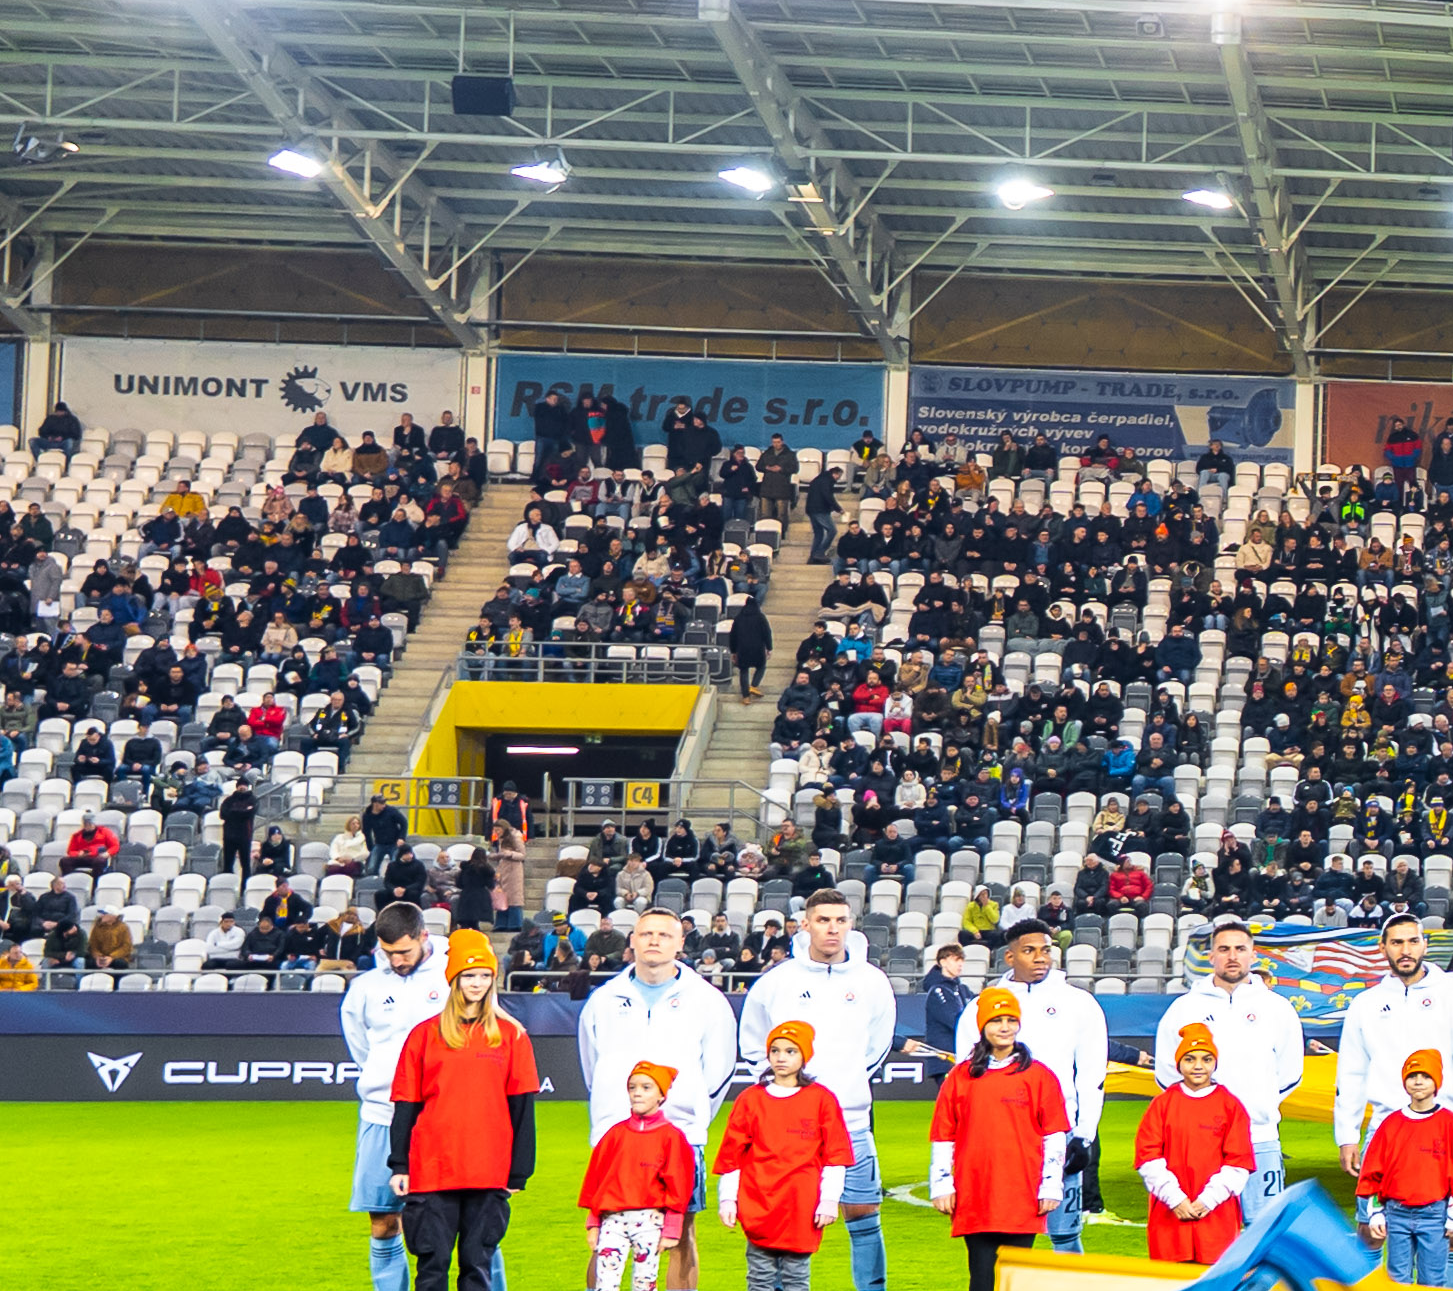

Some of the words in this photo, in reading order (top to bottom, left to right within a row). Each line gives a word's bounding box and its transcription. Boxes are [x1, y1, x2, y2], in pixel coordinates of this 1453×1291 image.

[114, 373, 270, 398] UNIMONT
[340, 381, 409, 403] VMS
[947, 376, 1077, 396] SLOVPUMP
[1105, 382, 1182, 401] TRADE,
[1188, 386, 1240, 400] s.r.o.
[763, 395, 870, 427] s.r.o.
[917, 406, 1007, 423] Slovenský
[1012, 410, 1081, 424] výrobca
[1087, 410, 1175, 428] čerpadiel,
[1045, 425, 1094, 440] vývev
[379, 783, 401, 801] C5
[631, 786, 654, 804] C4
